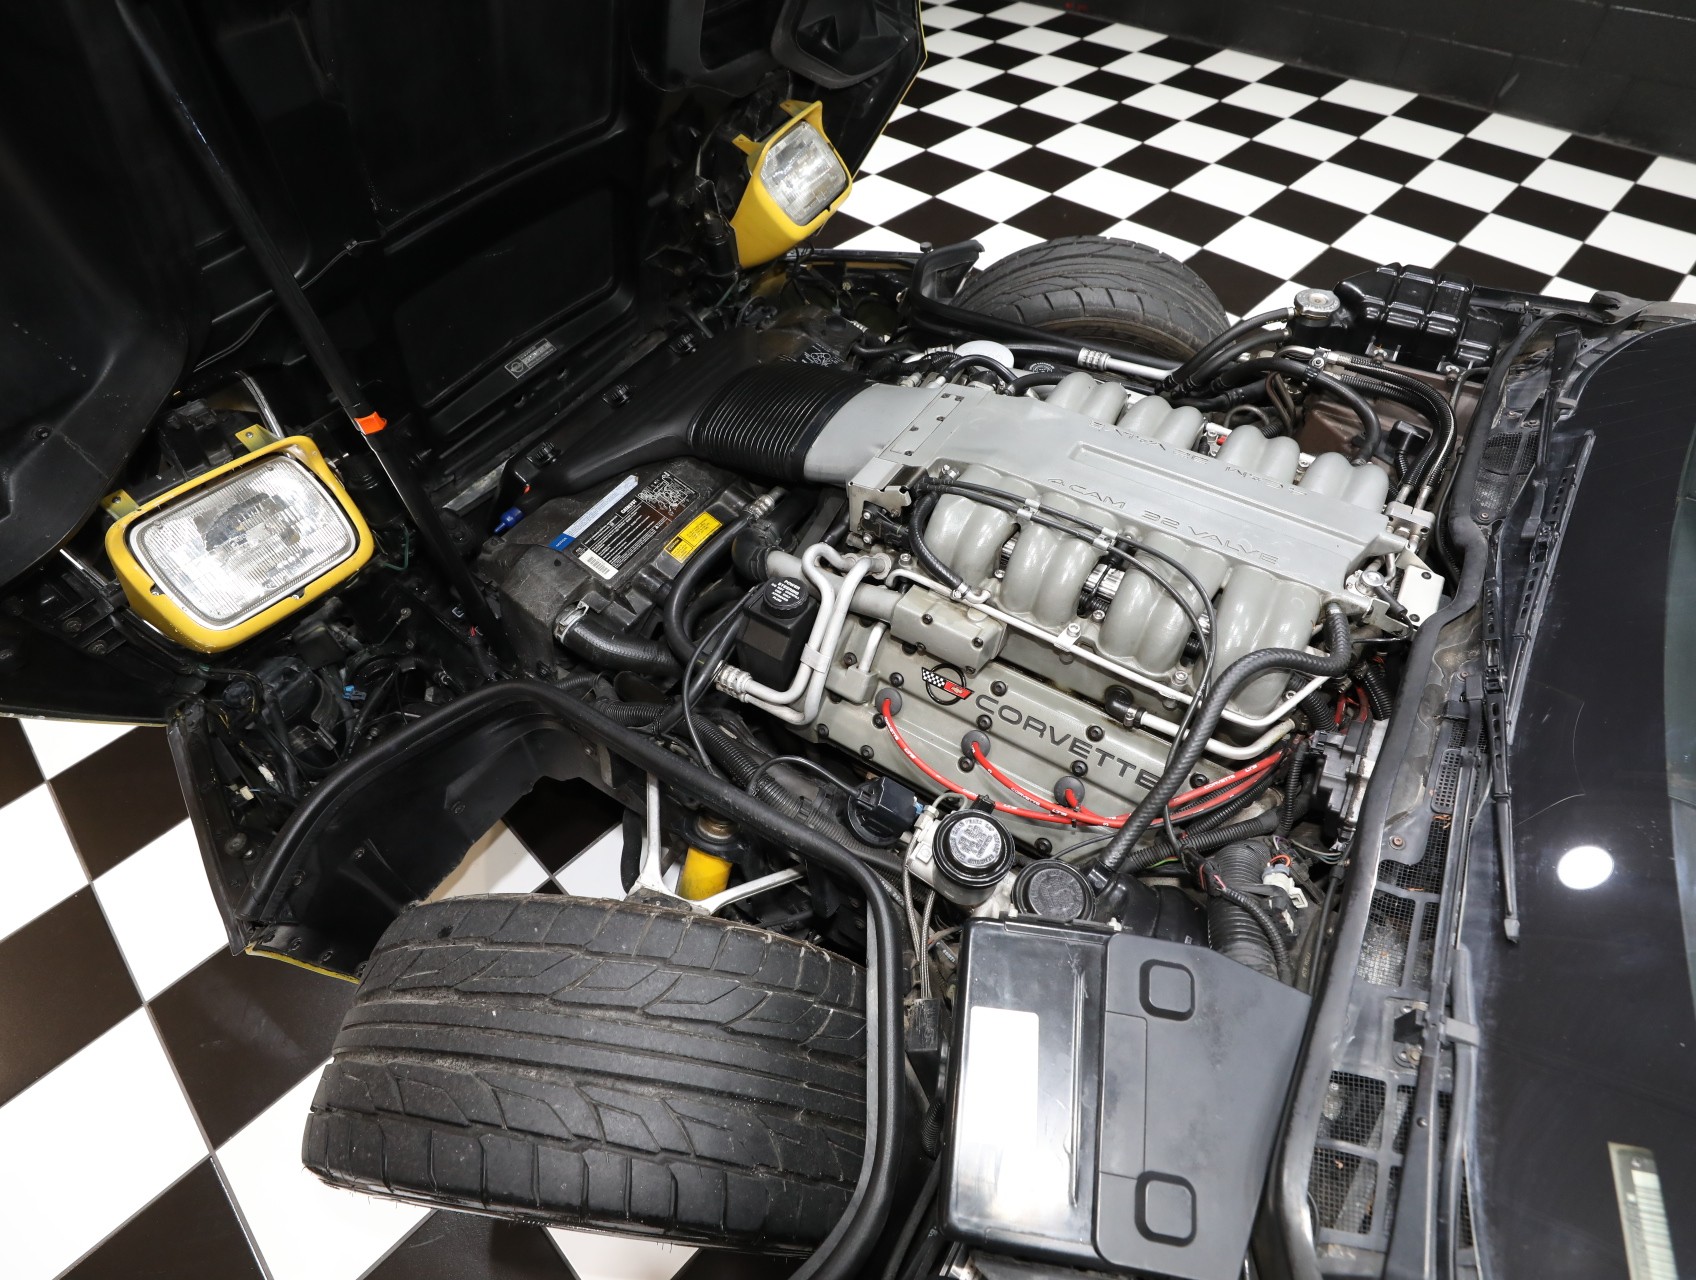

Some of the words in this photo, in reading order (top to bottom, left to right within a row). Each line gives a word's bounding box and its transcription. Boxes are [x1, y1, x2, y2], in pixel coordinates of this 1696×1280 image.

[1069, 484, 1126, 509] CAM
[1142, 509, 1181, 530] 32
[1188, 525, 1279, 565] VALVE
[777, 582, 800, 596] STEERING
[783, 579, 801, 591] POWER
[975, 694, 1161, 791] CORVETTE
[1204, 774, 1236, 790] CORVETTE
[1010, 787, 1041, 806] CORVETTE
